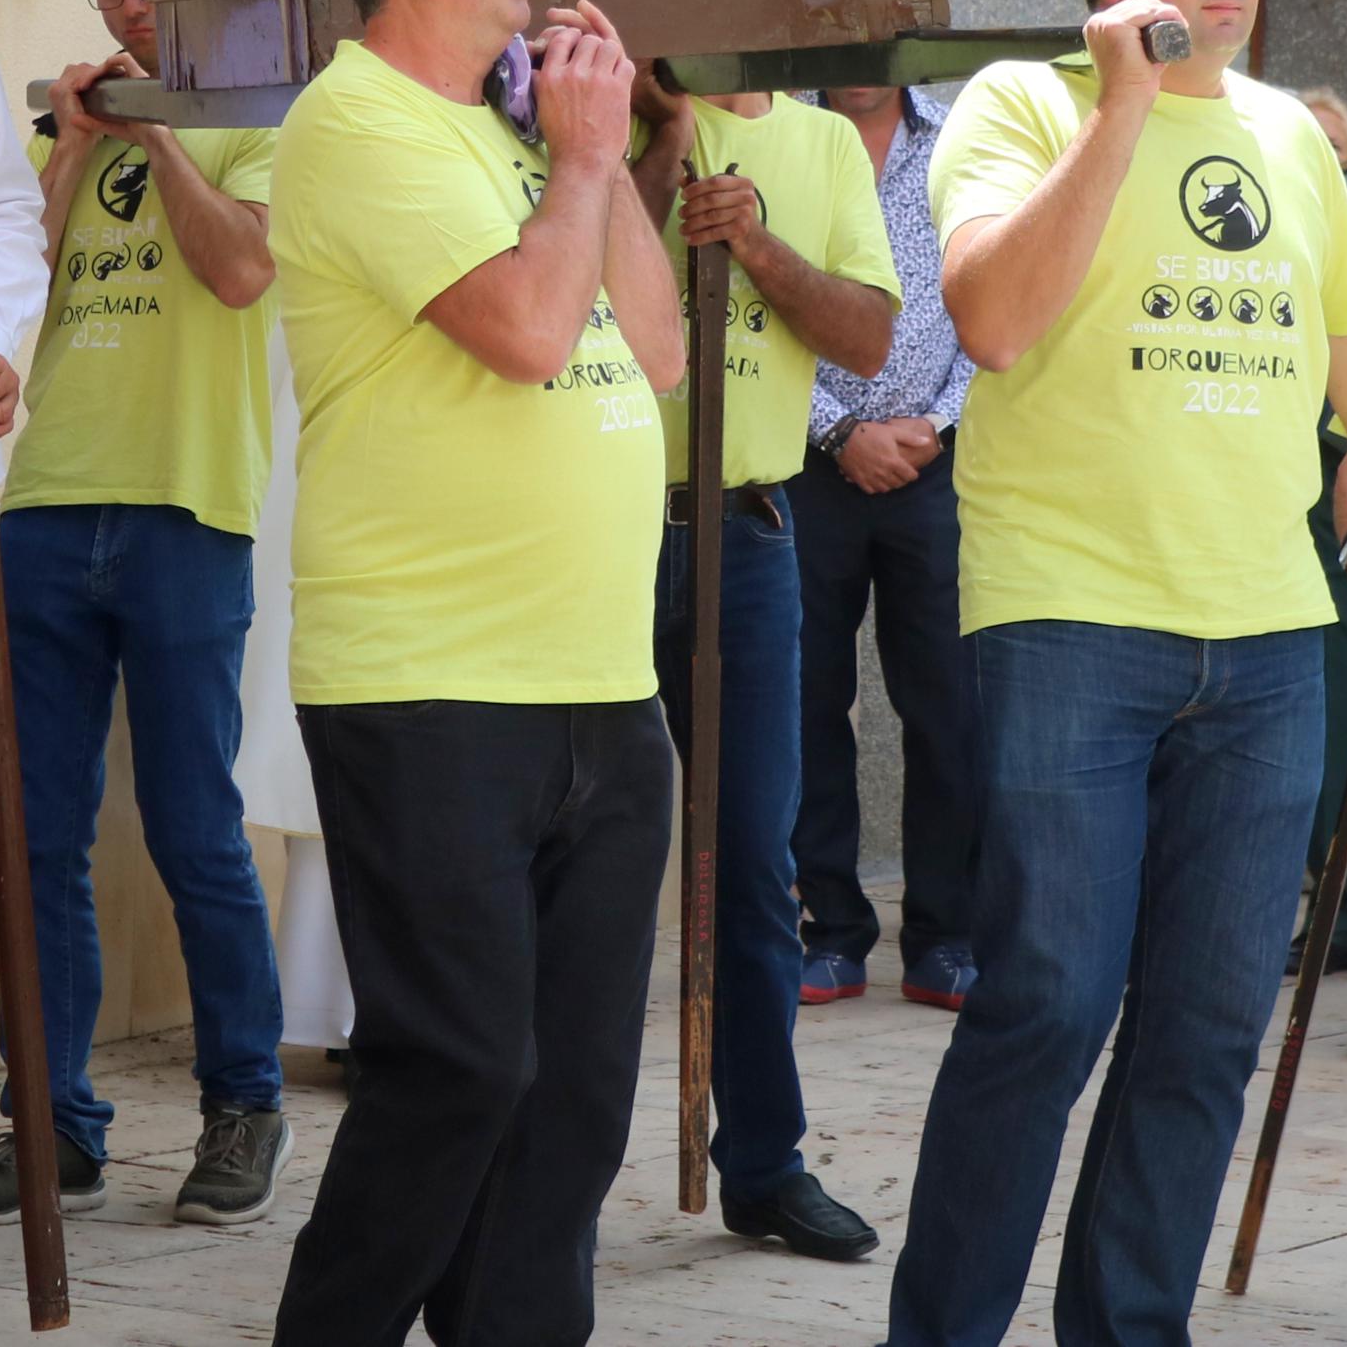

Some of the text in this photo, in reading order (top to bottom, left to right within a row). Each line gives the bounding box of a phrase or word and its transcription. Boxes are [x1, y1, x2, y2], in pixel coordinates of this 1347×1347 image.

[73, 228, 94, 247] SE
[1155, 254, 1292, 286] SE BUSCAN
[57, 295, 161, 326] OREMADA
[71, 322, 121, 349] 022
[1129, 347, 1297, 380] TORQUEMADA
[1183, 381, 1261, 416] 2022
